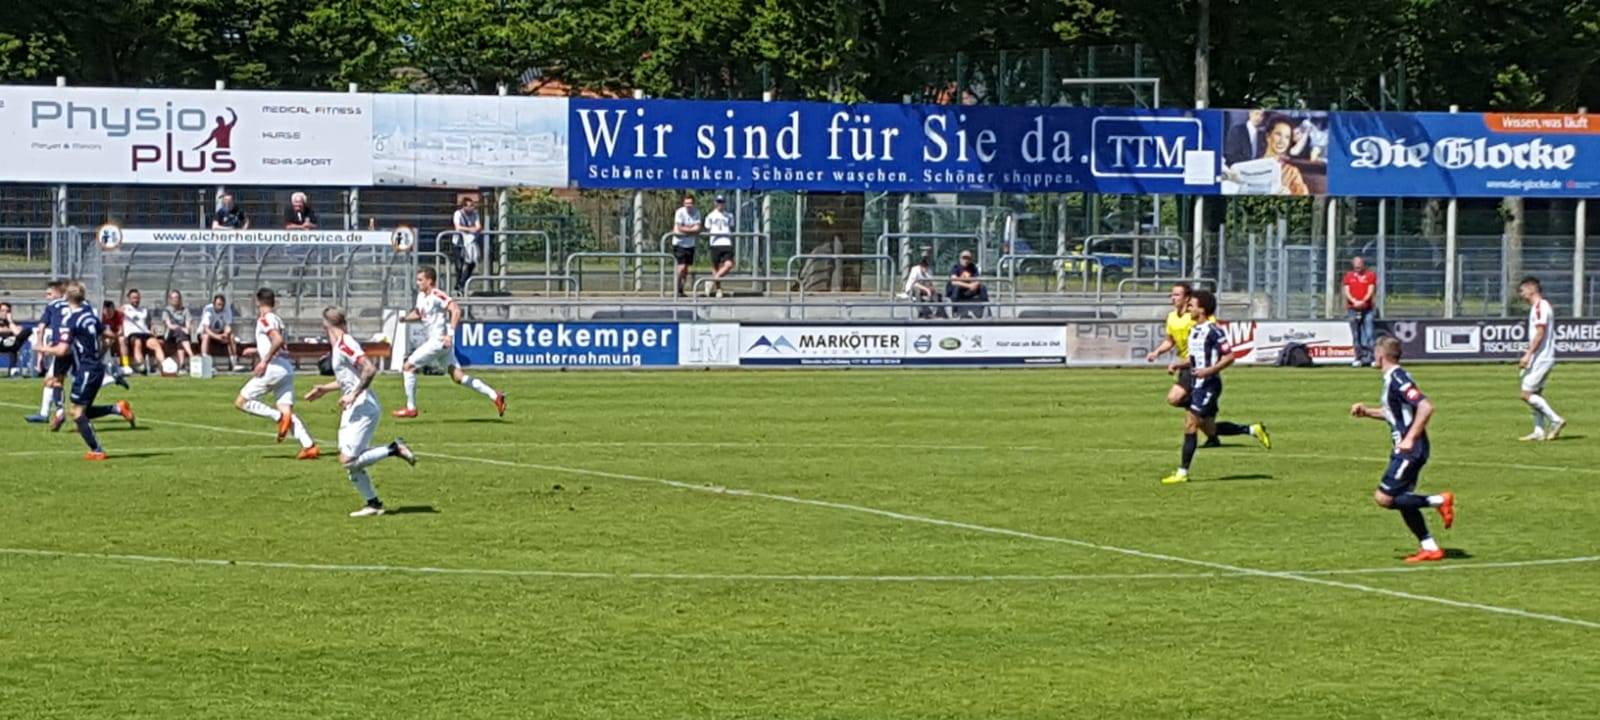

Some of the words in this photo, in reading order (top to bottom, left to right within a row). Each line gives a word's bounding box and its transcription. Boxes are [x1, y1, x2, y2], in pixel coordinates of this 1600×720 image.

[31, 101, 206, 137] Physio
[262, 105, 310, 114] MEDICAL
[315, 106, 362, 115] FITNESS
[576, 107, 673, 158] Wir
[696, 108, 802, 160] sind
[827, 111, 899, 161] für
[923, 113, 998, 163] Sie
[1021, 115, 1089, 164] da.
[1107, 135, 1186, 169] TTM
[1350, 136, 1428, 169] Die
[1434, 136, 1576, 170] Glocke
[262, 157, 333, 166] REHA-SPORT
[588, 165, 664, 179] Schöner
[673, 166, 741, 180] tanken.
[751, 165, 824, 181] Schöner
[832, 169, 914, 183] waschen.
[923, 169, 994, 183] Schöner
[152, 231, 363, 243] www.sicherheitundservice.de
[462, 322, 672, 351] Mestekemper
[799, 331, 900, 350] MARKÖTTER
[1482, 324, 1525, 340] OTTO
[1554, 324, 1600, 340] SMEIE
[1483, 342, 1530, 352] TISCHLERE
[494, 351, 641, 366] Bauunternehmung
